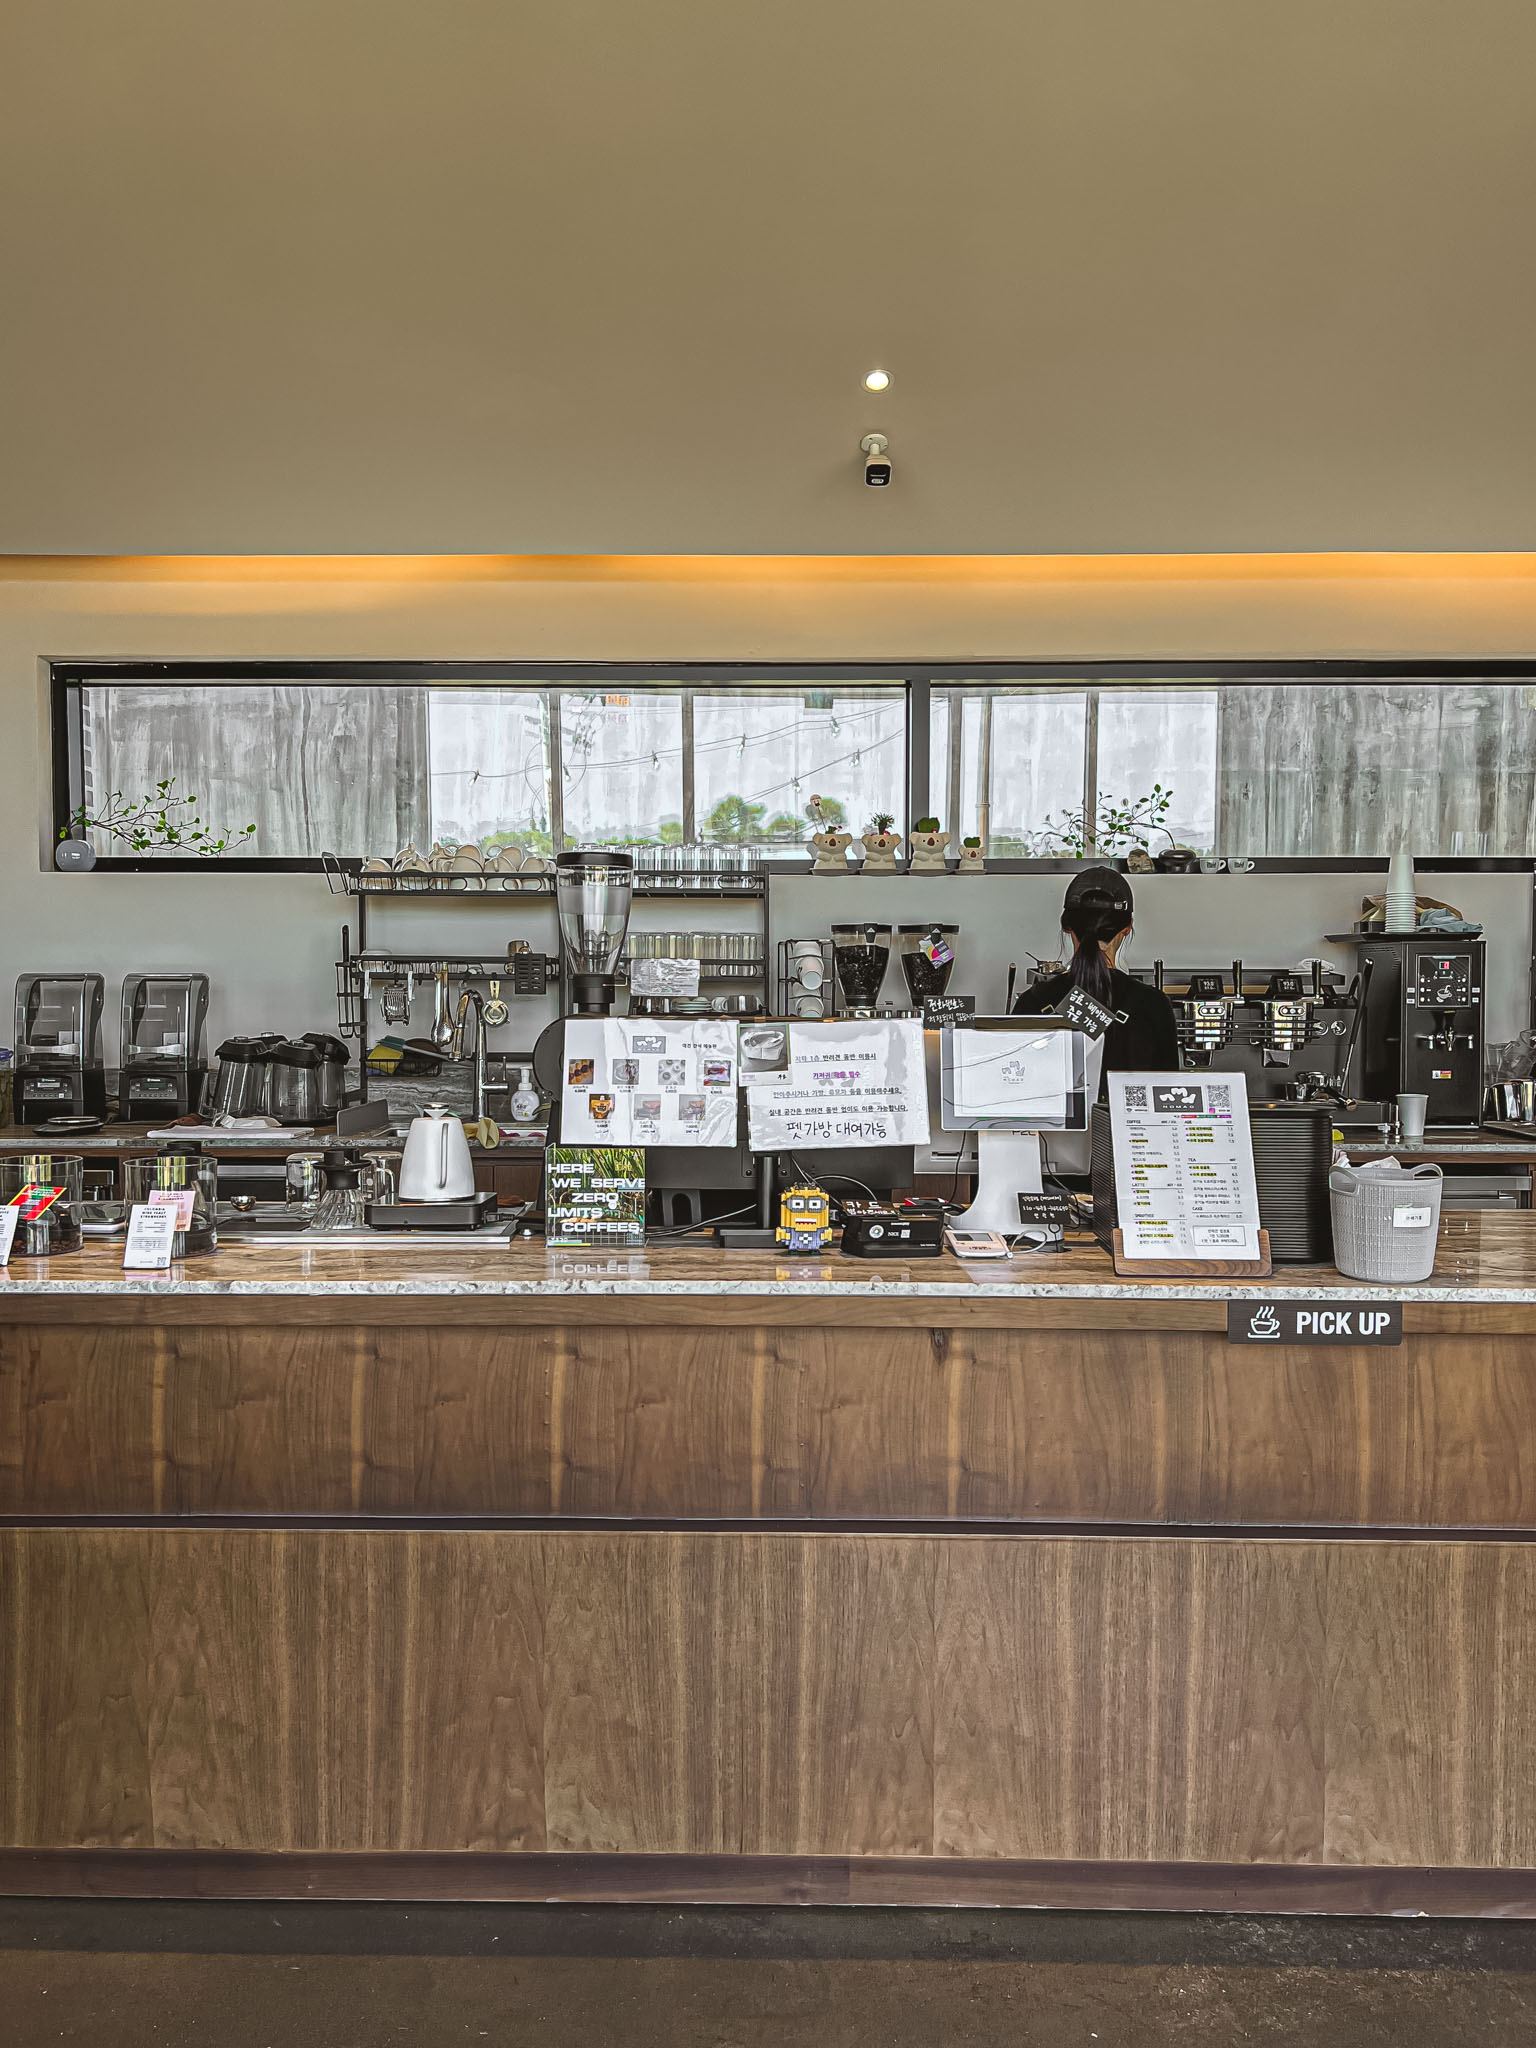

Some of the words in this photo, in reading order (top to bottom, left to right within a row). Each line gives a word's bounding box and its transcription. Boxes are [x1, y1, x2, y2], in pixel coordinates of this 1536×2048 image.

[1066, 1004, 1082, 1023] 주문
[1084, 1016, 1098, 1032] 가능
[548, 1164, 594, 1174] HERE
[552, 1178, 581, 1188] WE
[591, 1178, 645, 1188] SERVE
[572, 1192, 619, 1202] ZERO
[548, 1208, 602, 1218] LIMITS
[1296, 1312, 1352, 1335] PICK
[1359, 1312, 1391, 1335] UP
